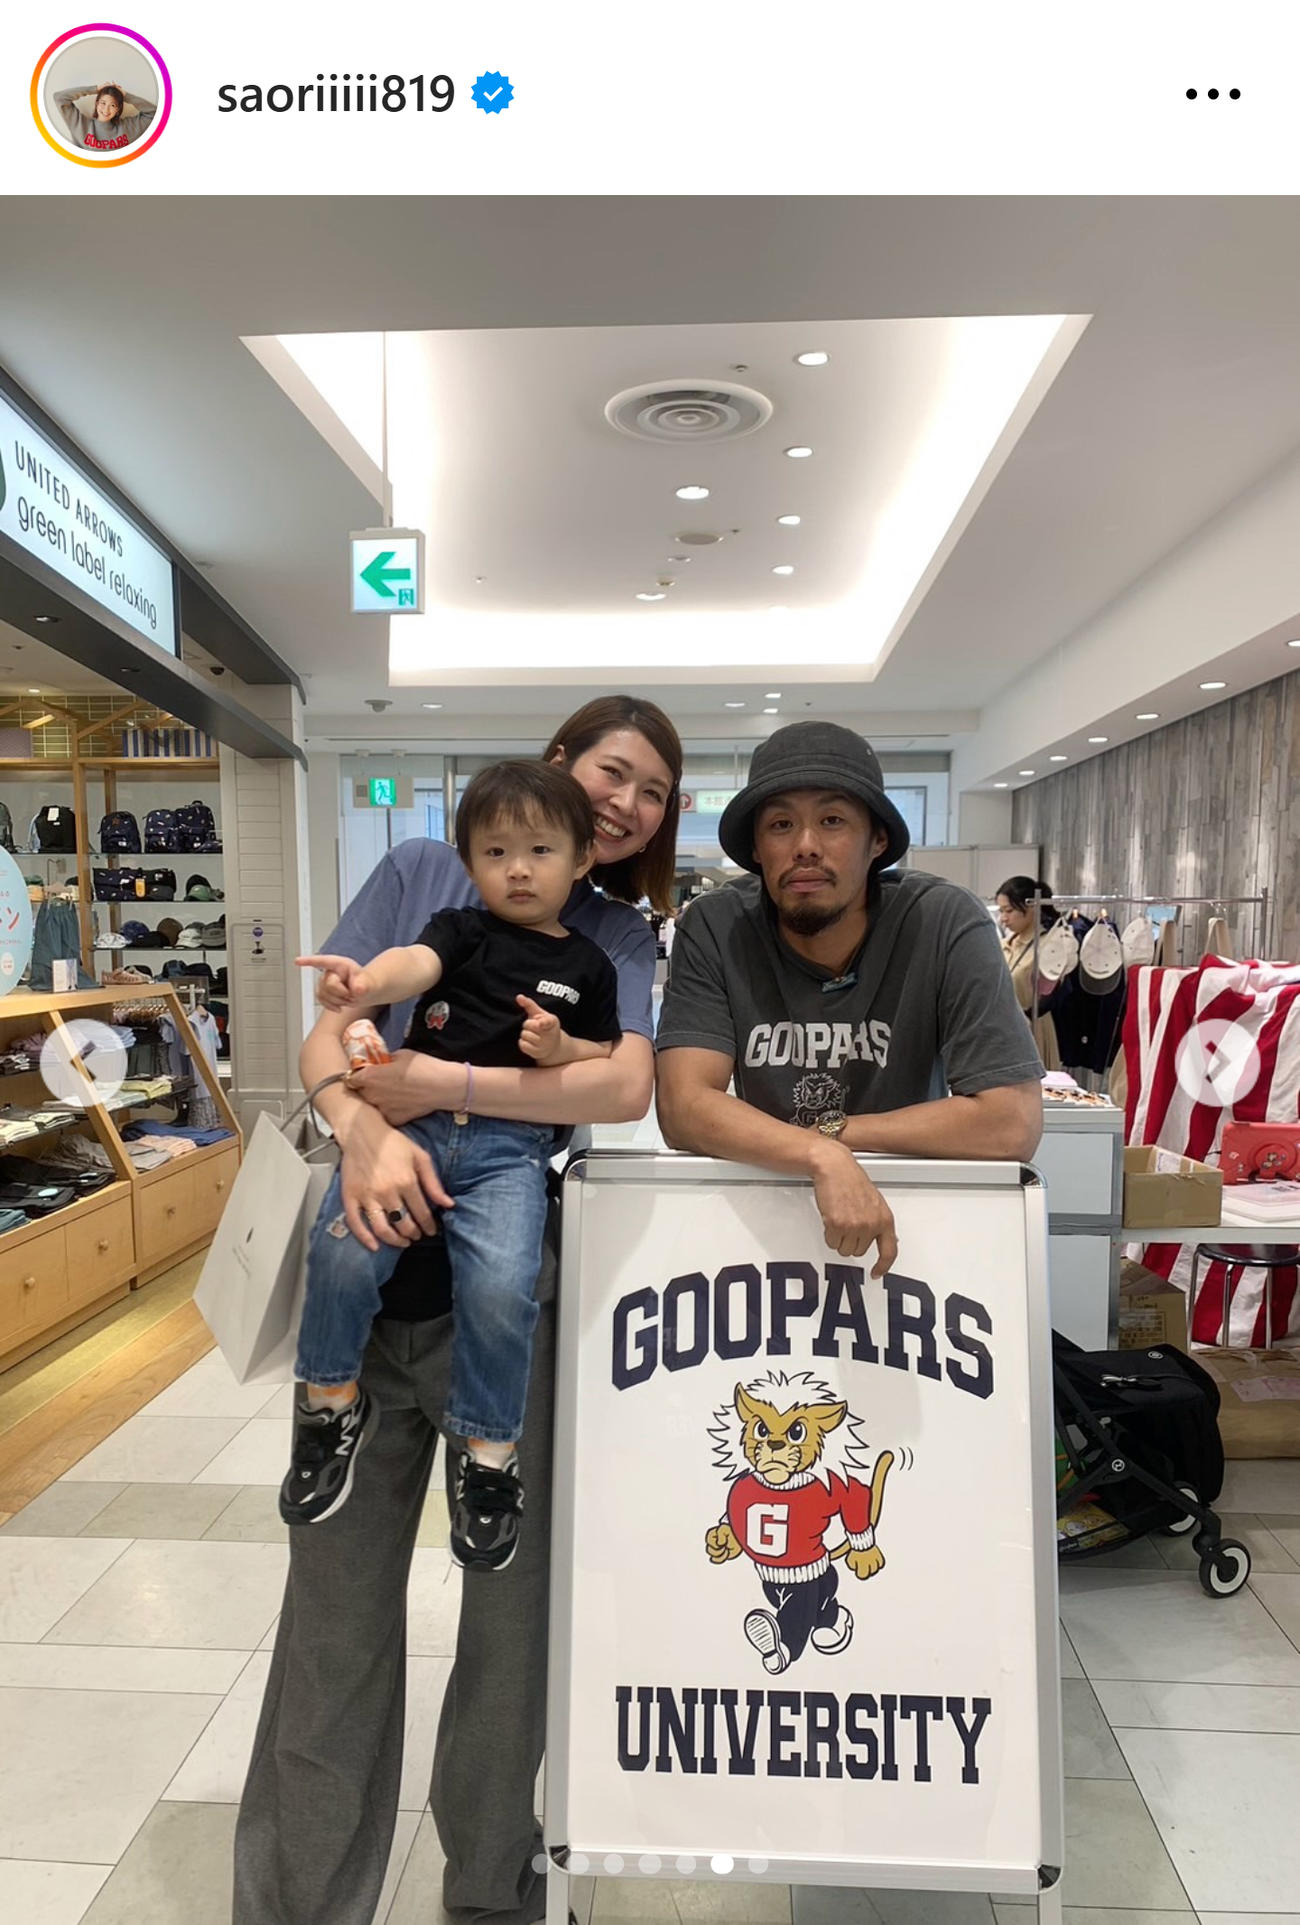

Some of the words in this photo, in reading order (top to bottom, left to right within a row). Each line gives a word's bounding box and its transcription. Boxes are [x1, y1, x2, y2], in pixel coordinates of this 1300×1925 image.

[15, 440, 71, 510] UNITED
[75, 498, 123, 557] ARROWS
[18, 496, 67, 554] green
[71, 530, 106, 585] label
[109, 569, 157, 630] relaxing
[612, 1261, 994, 1399] GOOPARS
[745, 1503, 790, 1557] G
[615, 1685, 992, 1785] UNIVERSITY
